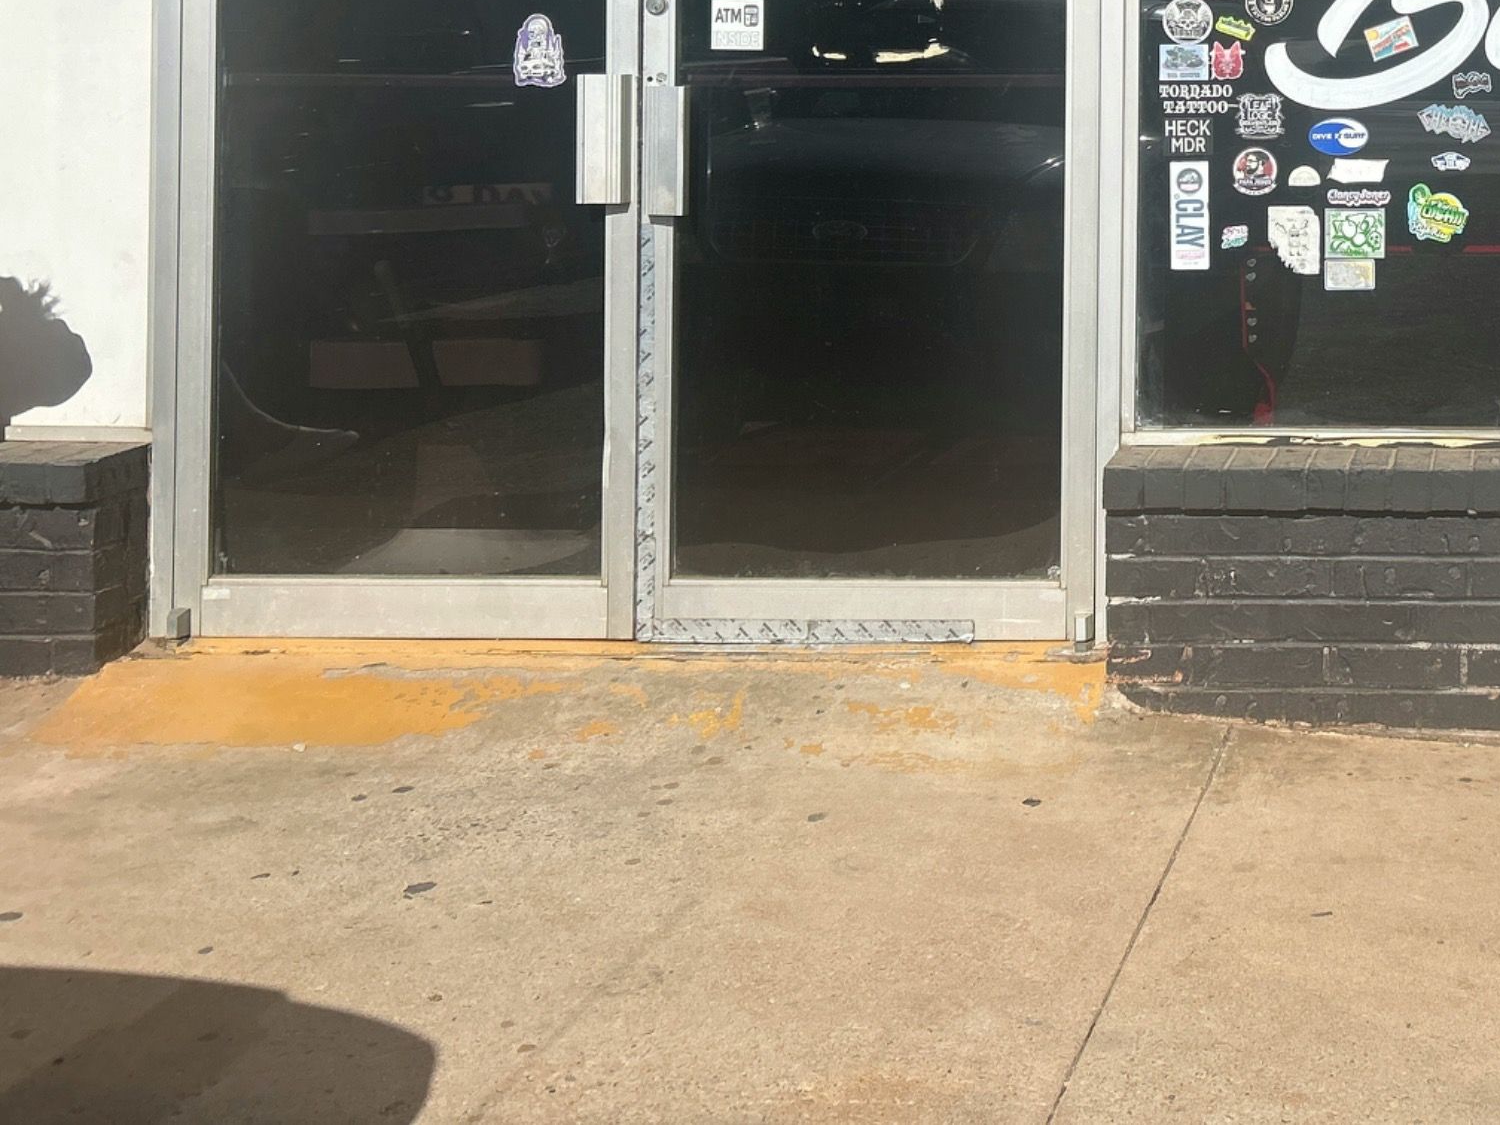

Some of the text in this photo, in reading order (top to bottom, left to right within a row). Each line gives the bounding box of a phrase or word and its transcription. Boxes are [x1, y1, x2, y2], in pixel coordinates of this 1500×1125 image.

[714, 7, 742, 24] ATM
[714, 30, 760, 47] INSIDE
[1158, 84, 1233, 99] TORNADO
[1162, 100, 1229, 115] TATTOO
[1164, 119, 1211, 137] HECK
[1312, 132, 1332, 140] DIVE
[1170, 137, 1206, 154] MDR
[1175, 199, 1205, 248] CLAY
